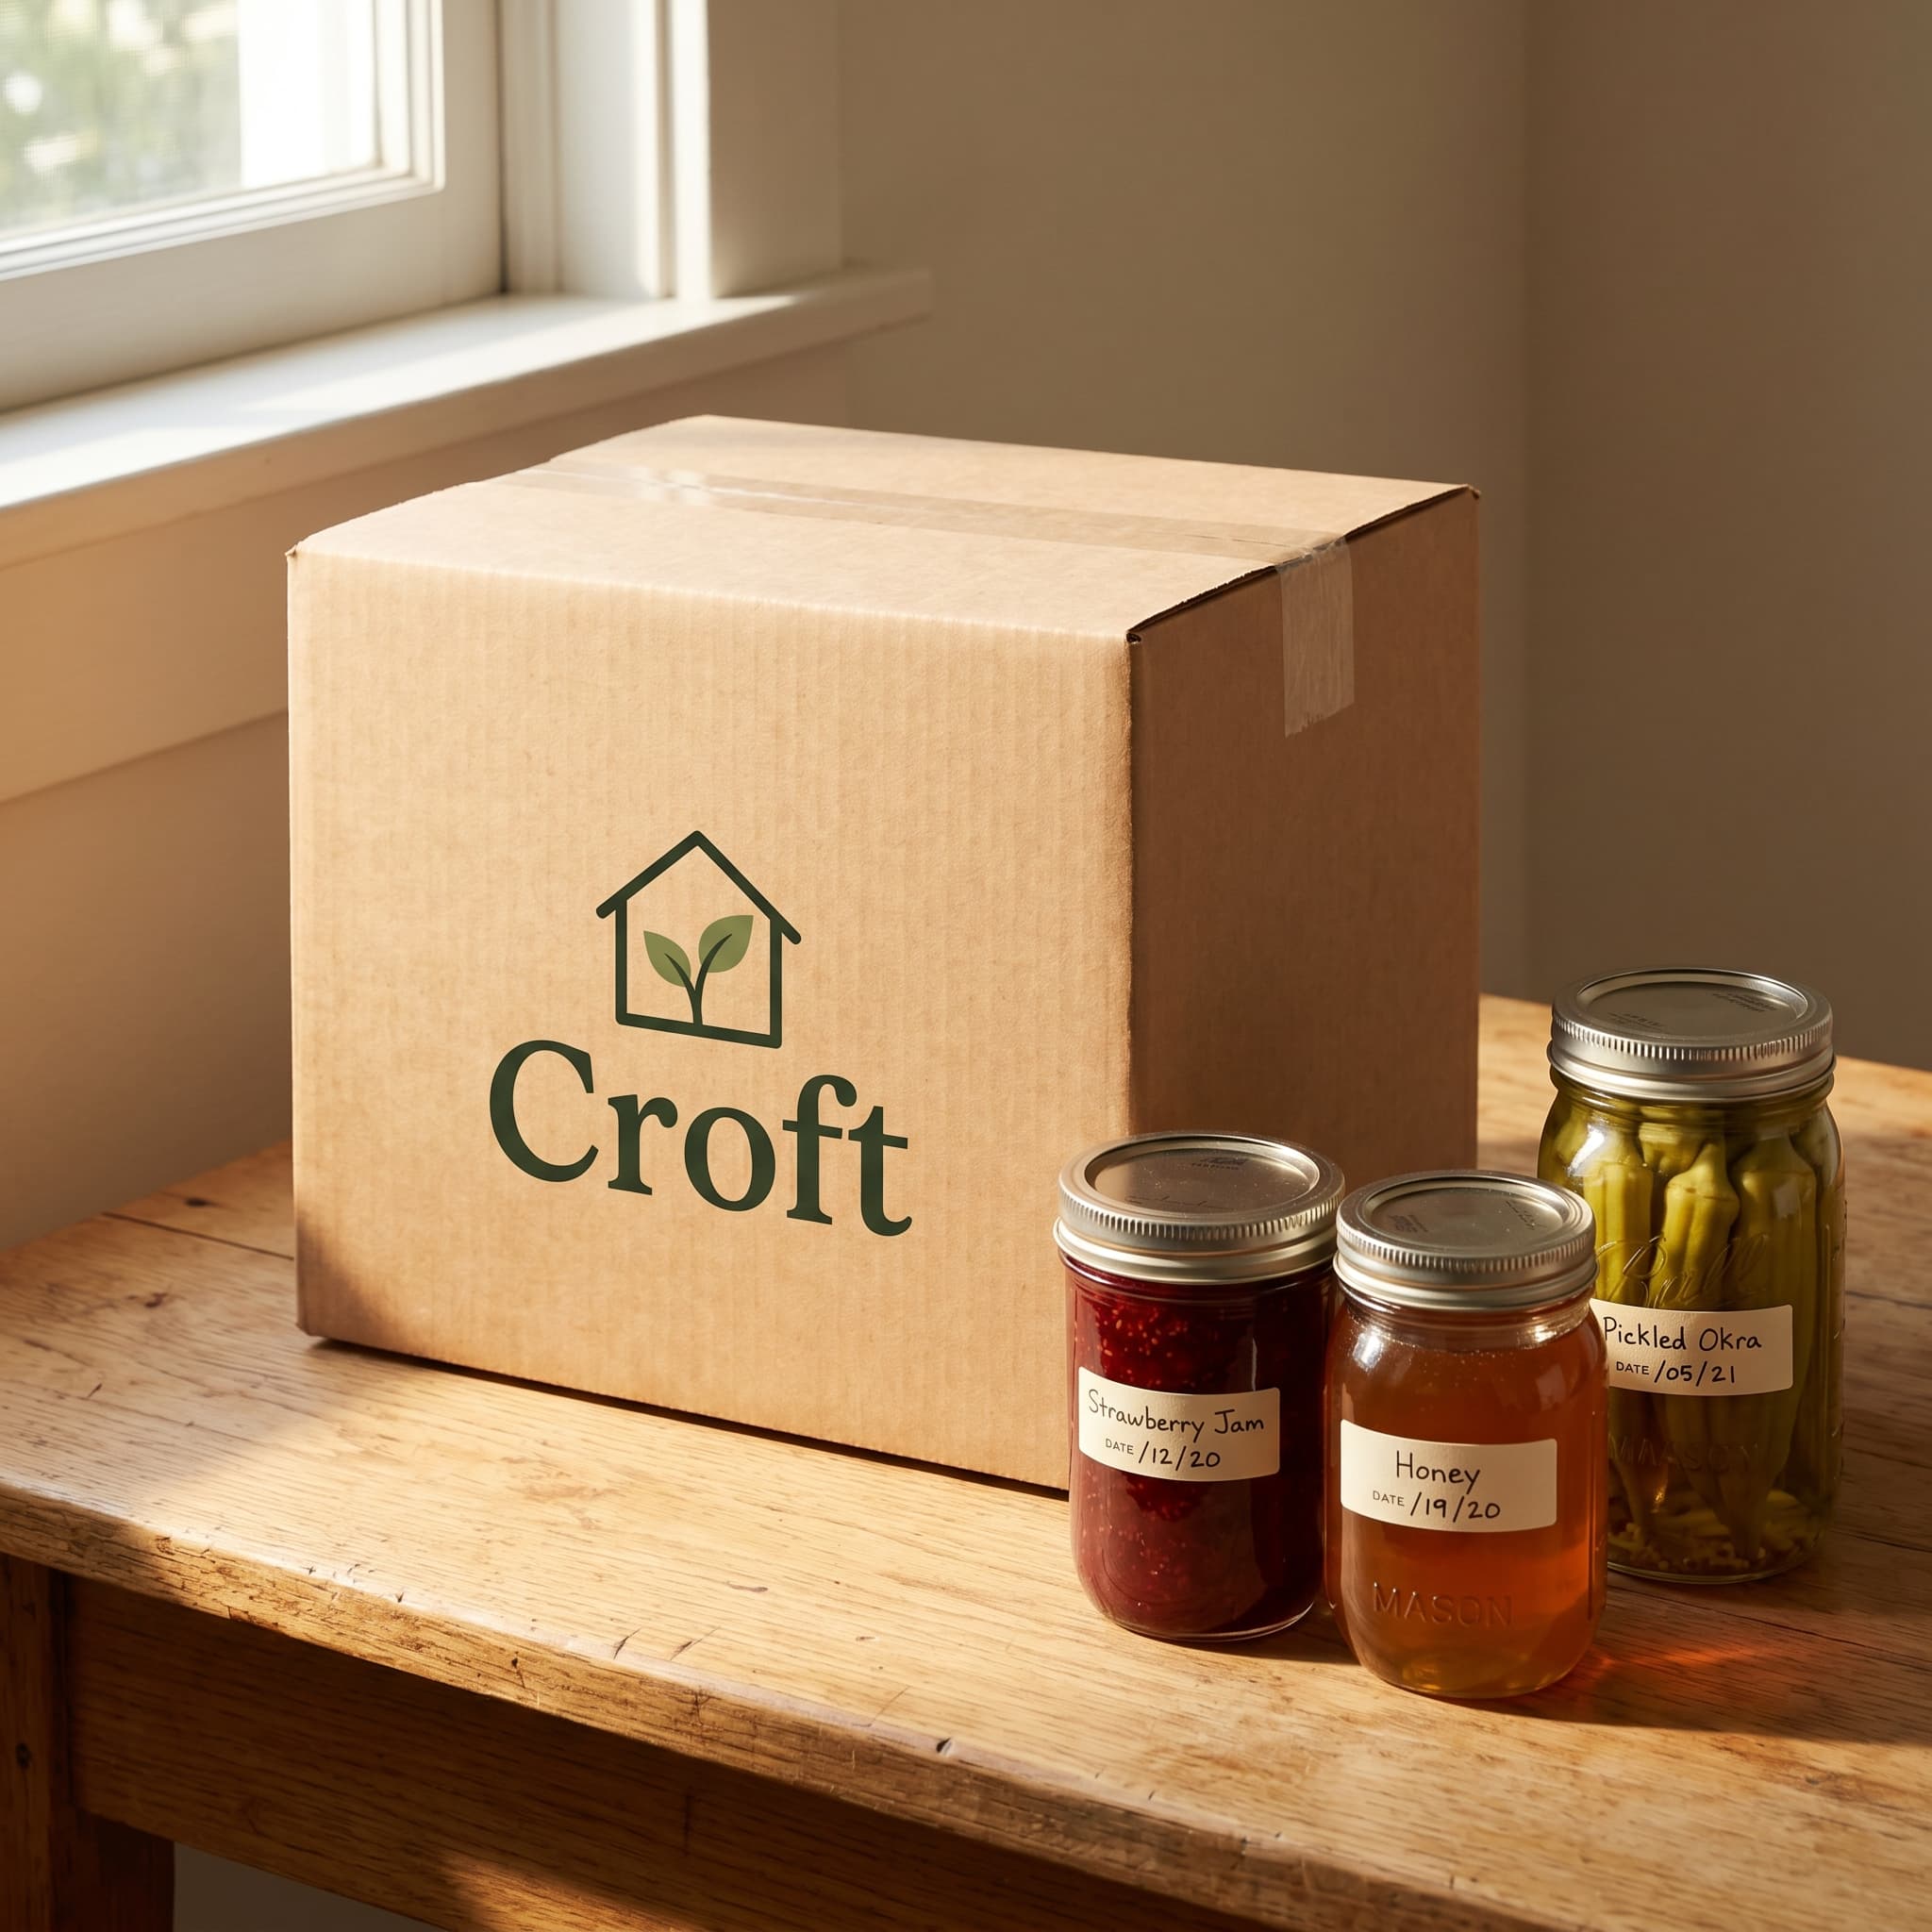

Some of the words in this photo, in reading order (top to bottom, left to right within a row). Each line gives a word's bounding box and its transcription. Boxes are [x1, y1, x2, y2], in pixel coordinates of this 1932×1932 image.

[490, 1040, 912, 1236] Croft
[1603, 1316, 1687, 1350] Pickled
[1699, 1326, 1762, 1352] Okra
[1616, 1361, 1650, 1375] DATE
[1654, 1359, 1735, 1387] /05/21
[1089, 1389, 1205, 1442] Strawberry
[1214, 1408, 1264, 1434] Jam
[1106, 1438, 1134, 1455] DATE
[1139, 1441, 1221, 1472] /12/20
[1396, 1450, 1480, 1494] Honey
[1373, 1491, 1405, 1507] DATE
[1410, 1491, 1501, 1523] /19/20
[1373, 1581, 1513, 1628] MASON
